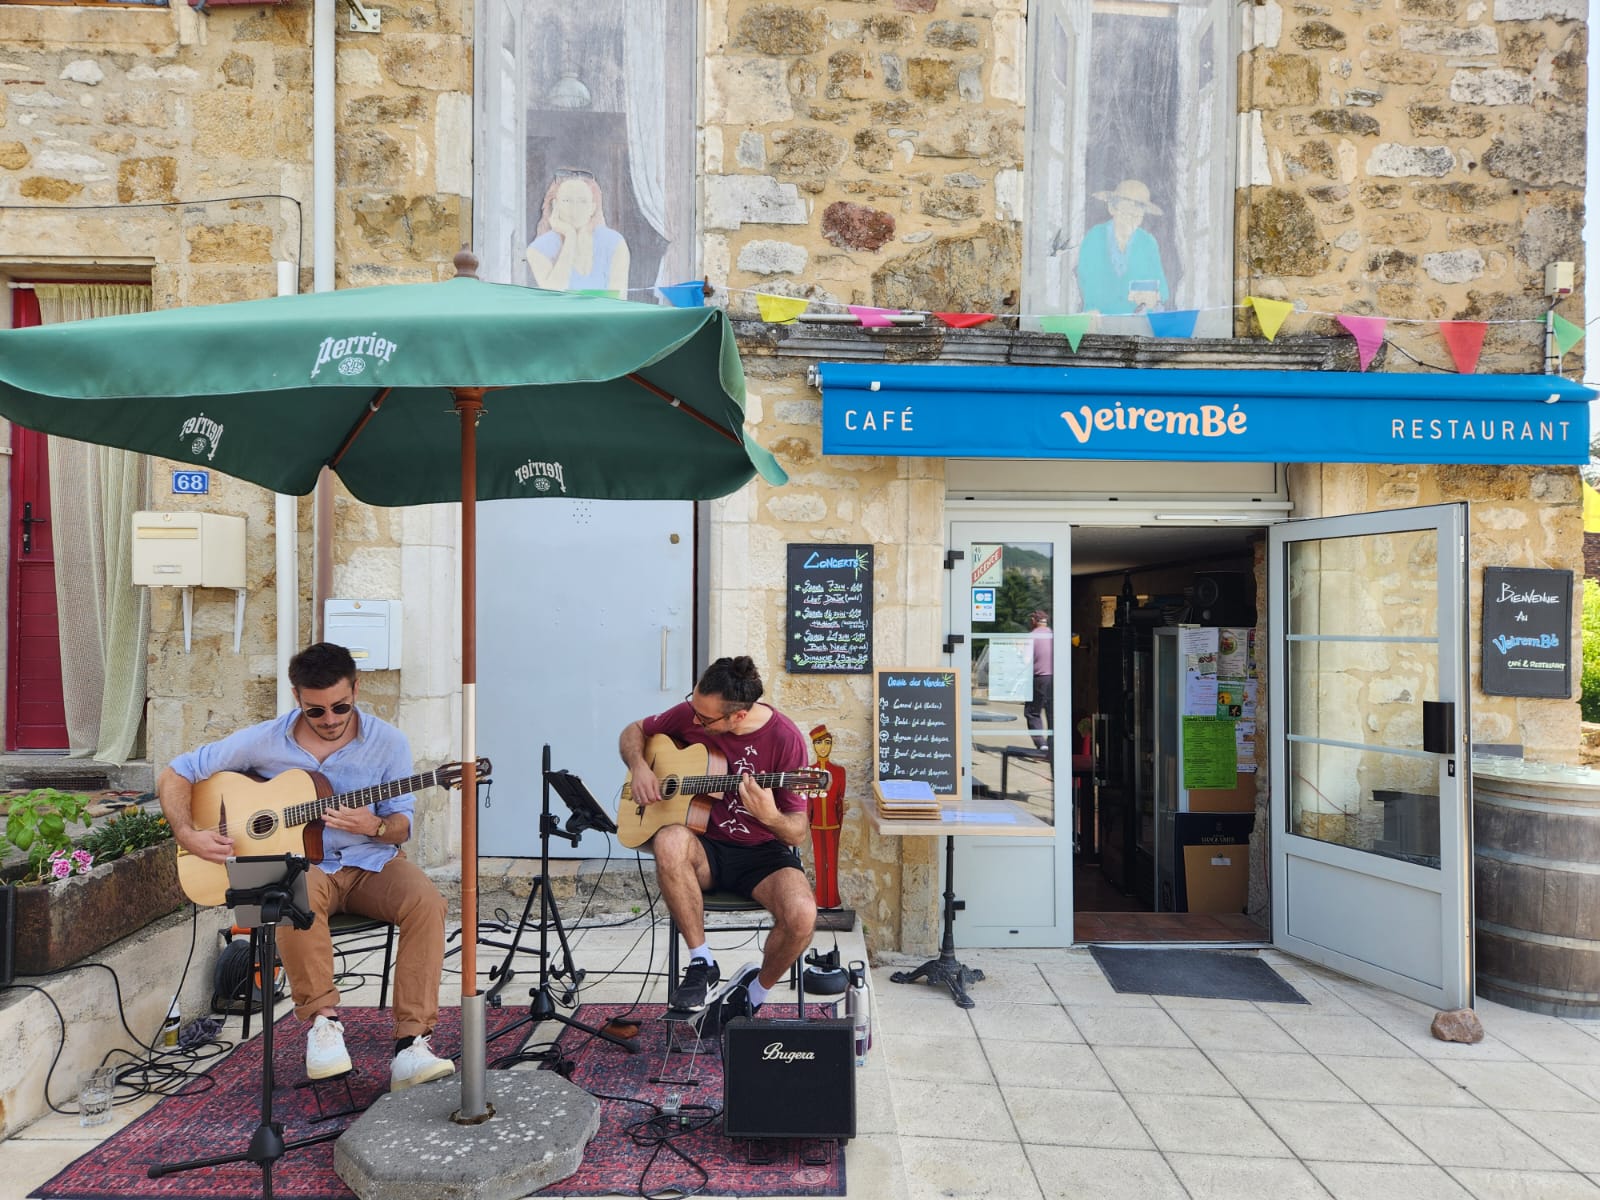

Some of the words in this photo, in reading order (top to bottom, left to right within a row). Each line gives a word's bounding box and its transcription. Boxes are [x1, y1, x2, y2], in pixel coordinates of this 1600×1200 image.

[845, 406, 914, 431] CAFÉ
[1061, 401, 1248, 444] VeiremBé
[1391, 418, 1570, 441] RESTAURANT
[177, 474, 203, 490] 68
[762, 1042, 816, 1064] Bugera
